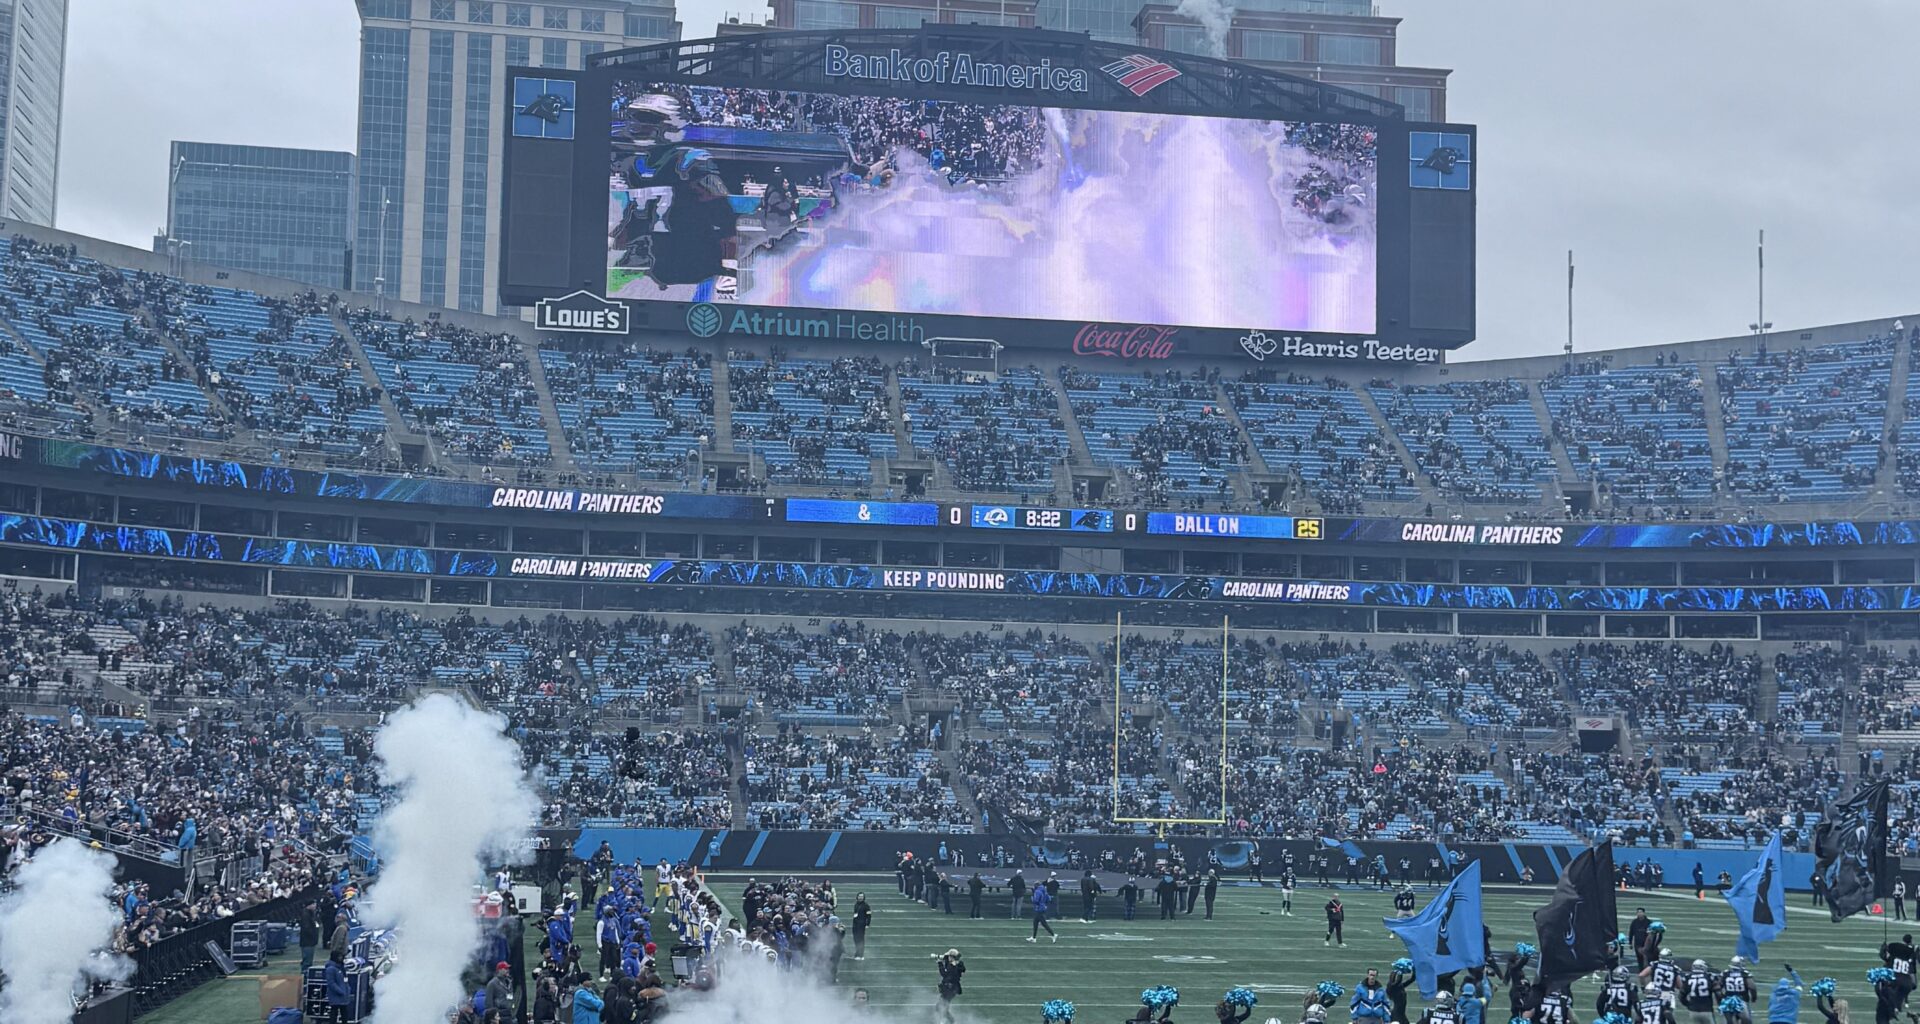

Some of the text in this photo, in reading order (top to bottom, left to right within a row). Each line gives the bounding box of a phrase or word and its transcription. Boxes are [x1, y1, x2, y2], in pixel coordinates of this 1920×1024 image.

[825, 44, 1088, 93] Bank of America
[545, 305, 620, 329] LOWE'S
[728, 309, 924, 342] Atrium Health
[1282, 336, 1439, 363] Harris Teeter
[492, 487, 664, 515] CAROLINA PANTHERS
[858, 503, 871, 521] &
[1026, 509, 1061, 528] 8:22
[1175, 515, 1239, 535] BALL ON
[1297, 519, 1319, 538] 25
[1401, 523, 1564, 545] CAROLINA PANTHERS
[511, 557, 653, 579] CAROLINA PANTHERS
[883, 569, 1004, 590] KEEP POUNDING
[1222, 581, 1351, 600] CAROLINA PANTHERS
[1653, 968, 1675, 988] 63
[1687, 978, 1709, 997] 72
[1606, 988, 1628, 1007] 79
[1539, 1004, 1563, 1024] 74
